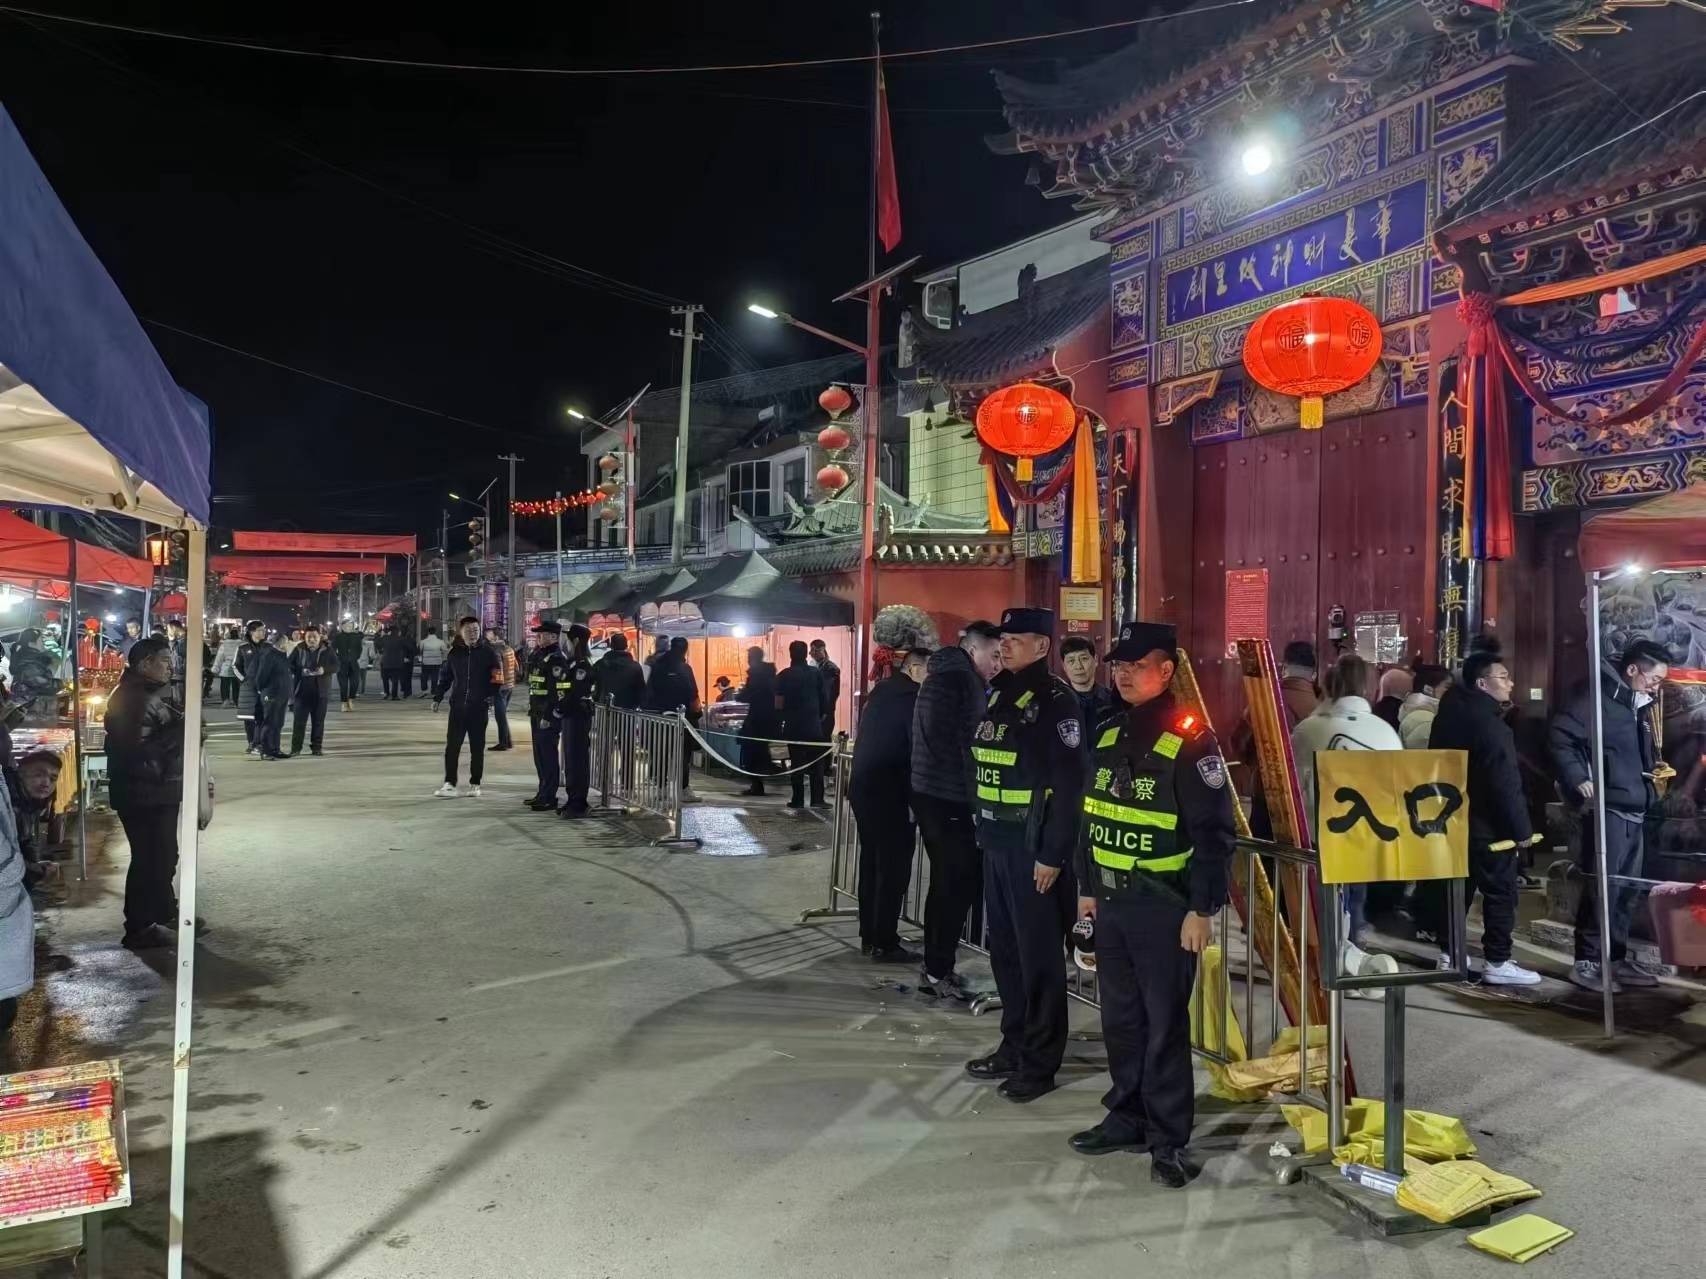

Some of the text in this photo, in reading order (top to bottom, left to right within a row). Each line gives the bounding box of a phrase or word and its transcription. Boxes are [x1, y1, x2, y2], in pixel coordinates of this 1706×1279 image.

[1279, 324, 1305, 349] 福
[1094, 766, 1156, 801] 警察
[1326, 782, 1463, 842] 入口
[1089, 822, 1153, 852] POLICE
